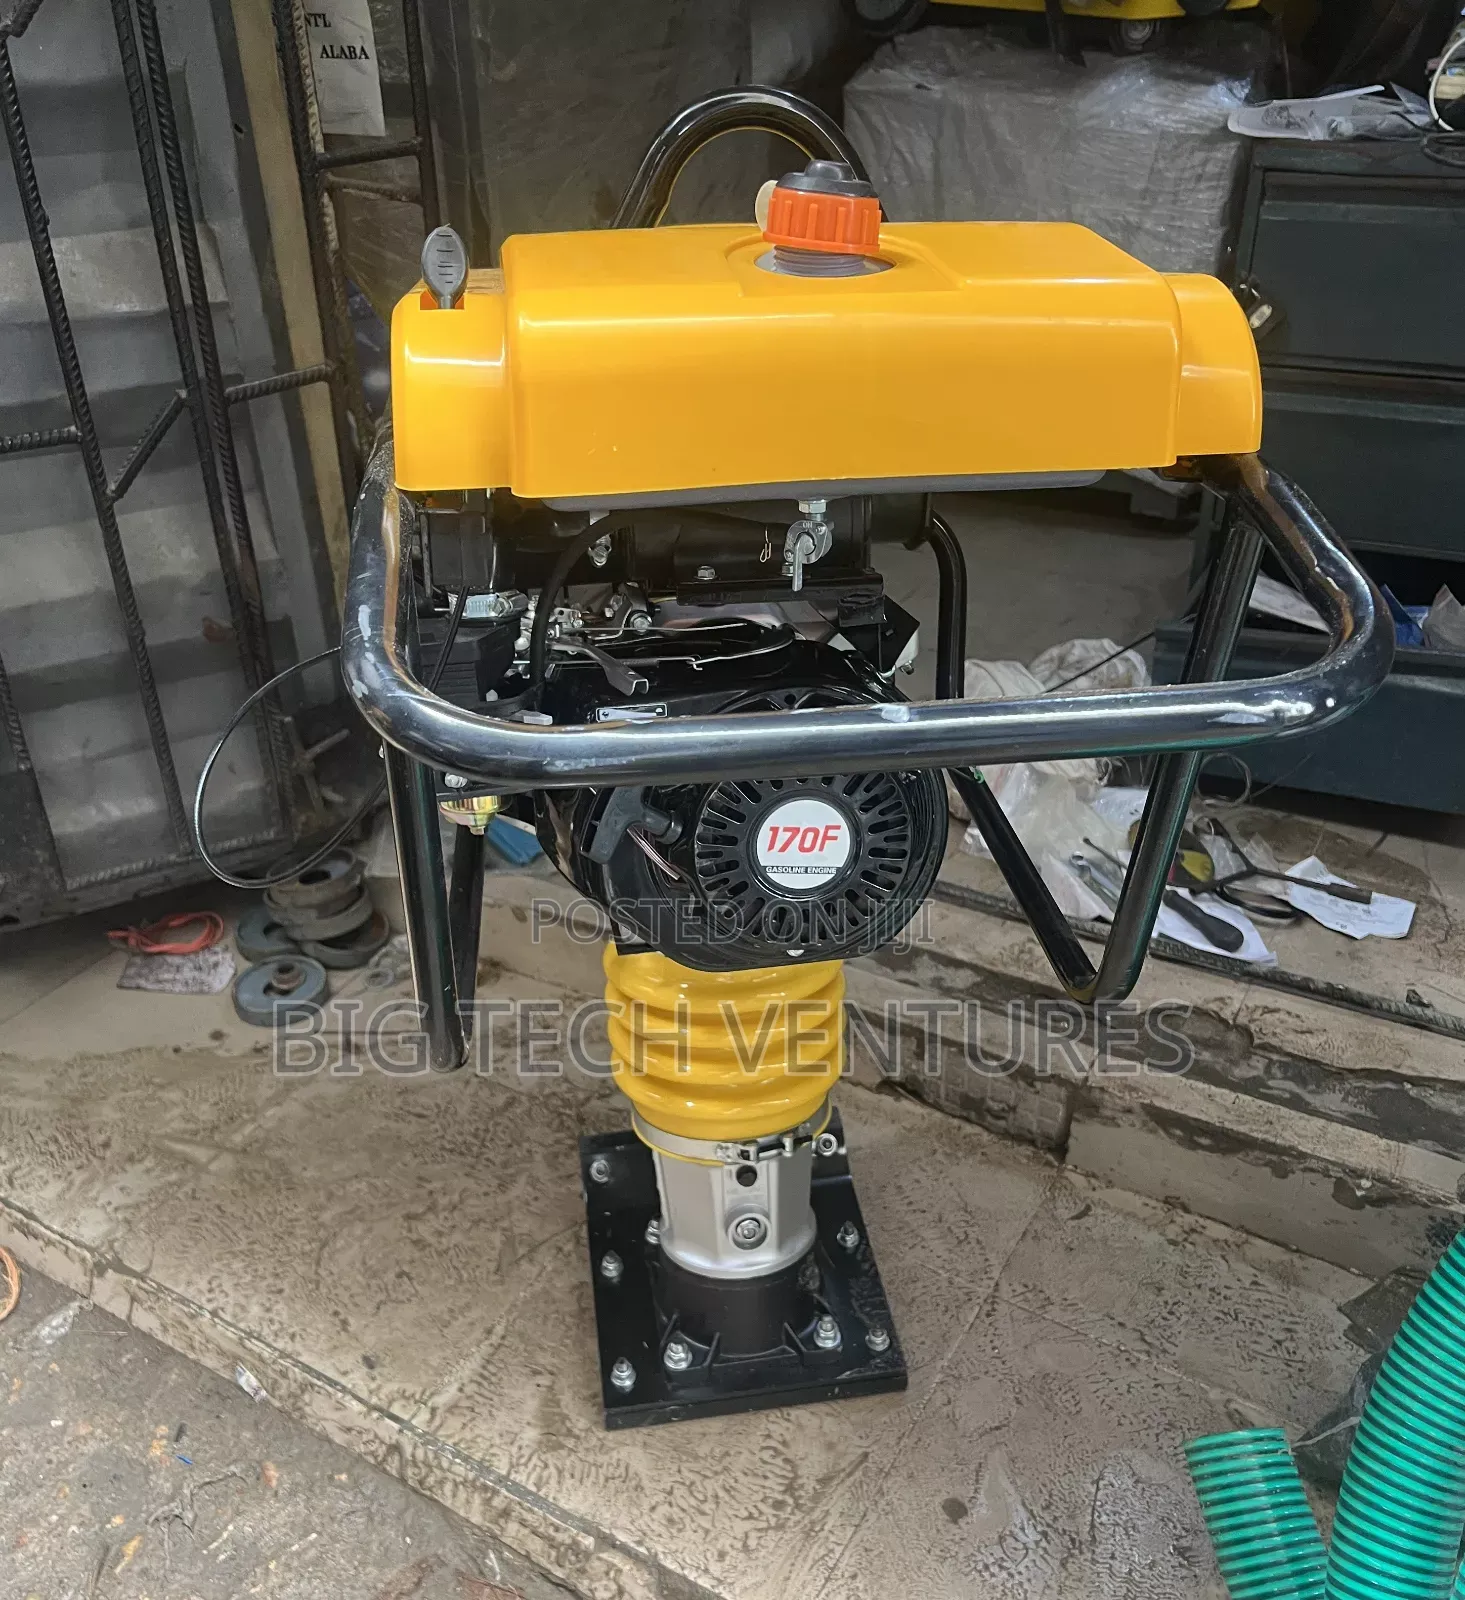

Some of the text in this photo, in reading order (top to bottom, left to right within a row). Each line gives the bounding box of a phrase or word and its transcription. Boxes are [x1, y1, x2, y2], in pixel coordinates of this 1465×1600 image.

[319, 44, 370, 60] ALABA
[767, 824, 841, 853] 170F
[766, 866, 837, 875] GASOLINE ENGINE
